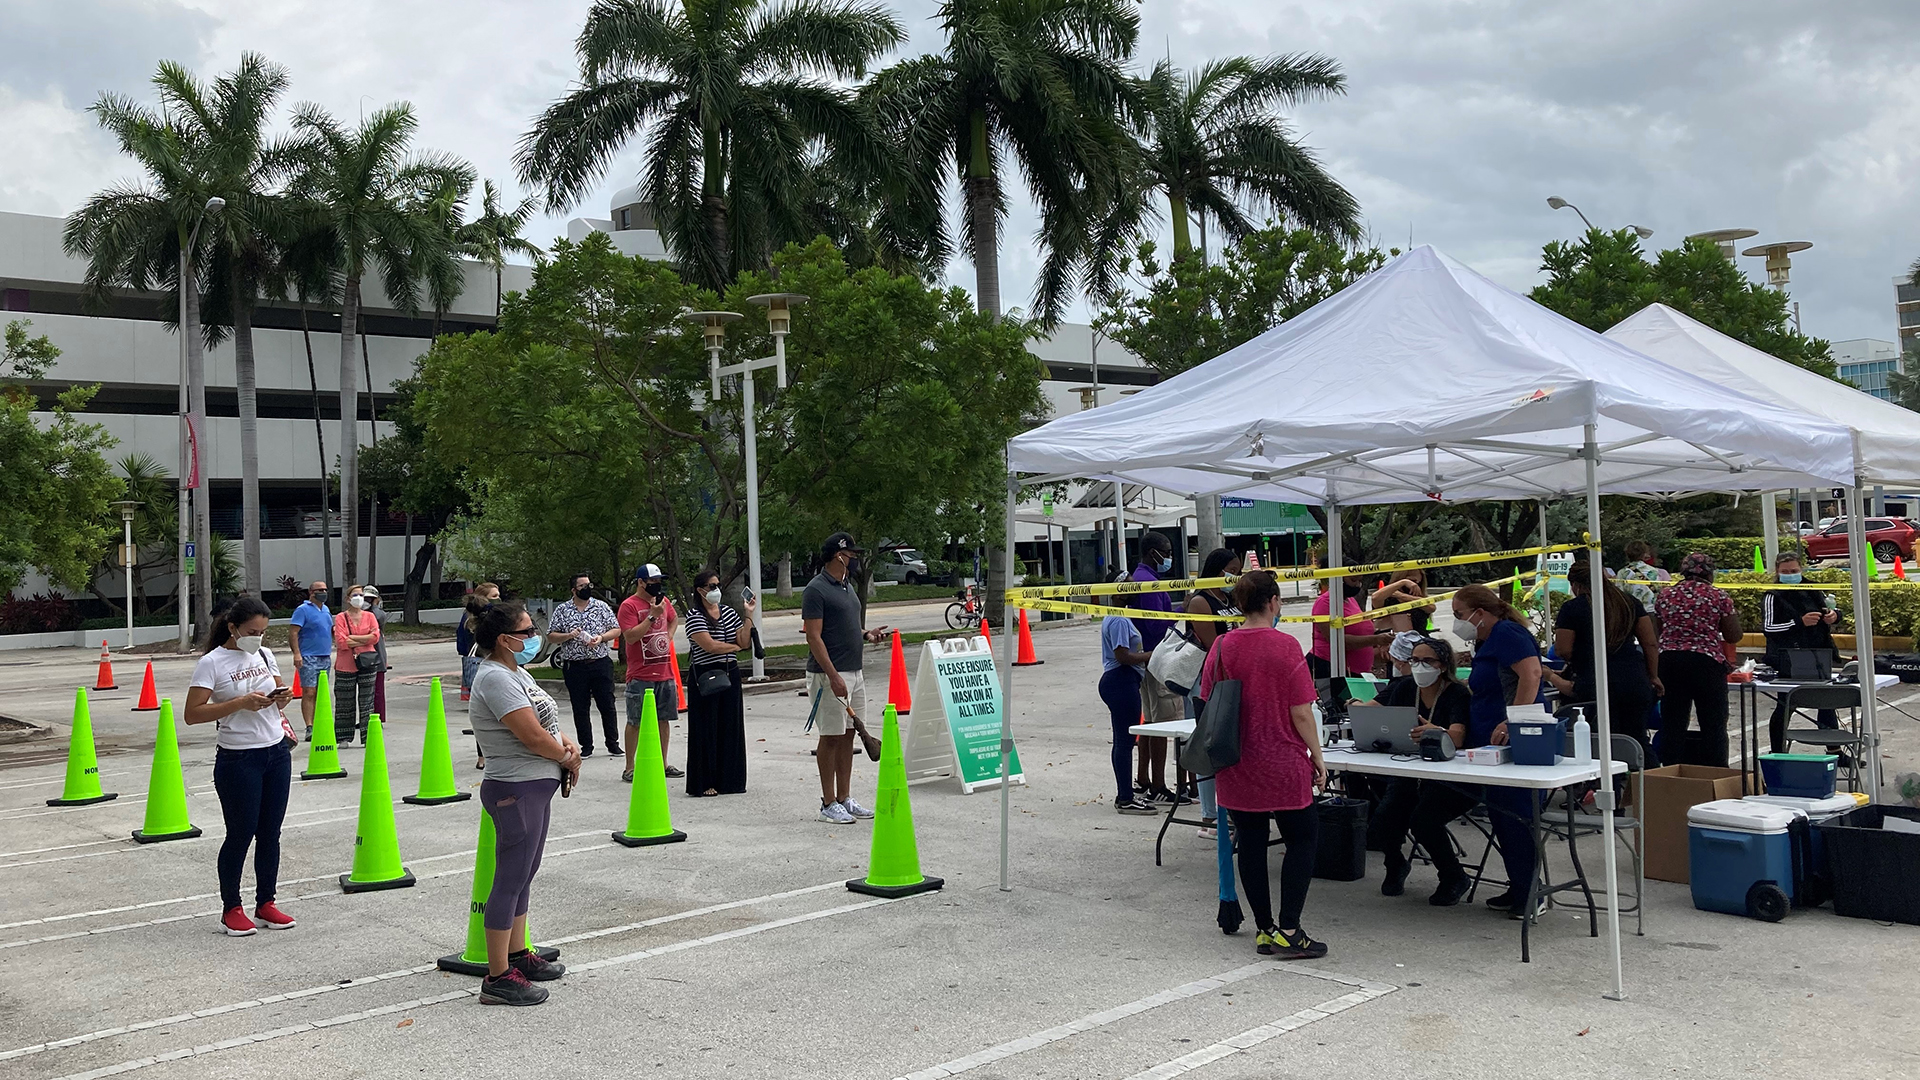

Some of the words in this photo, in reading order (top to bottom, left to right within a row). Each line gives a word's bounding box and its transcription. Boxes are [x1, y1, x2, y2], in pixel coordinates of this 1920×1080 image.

[1225, 500, 1240, 508] Miami
[1241, 500, 1254, 508] Beach
[1022, 588, 1045, 599] CAUTION
[1068, 585, 1092, 596] CAUTION
[1117, 582, 1142, 593] CAUTION
[1169, 579, 1196, 589] CAUTION
[1284, 570, 1315, 579] CAUTION
[1348, 563, 1380, 573] CAUTION
[1417, 557, 1450, 566] CAUTION
[938, 661, 966, 676] PLEASE
[966, 659, 994, 673] ENSURE
[948, 676, 965, 690] YOU
[964, 674, 984, 688] HAVE
[984, 673, 990, 686] A
[951, 690, 974, 704] MASK
[973, 689, 984, 702] ON
[985, 687, 994, 700] AT
[958, 704, 973, 718] ALL
[971, 701, 995, 716] TIMES
